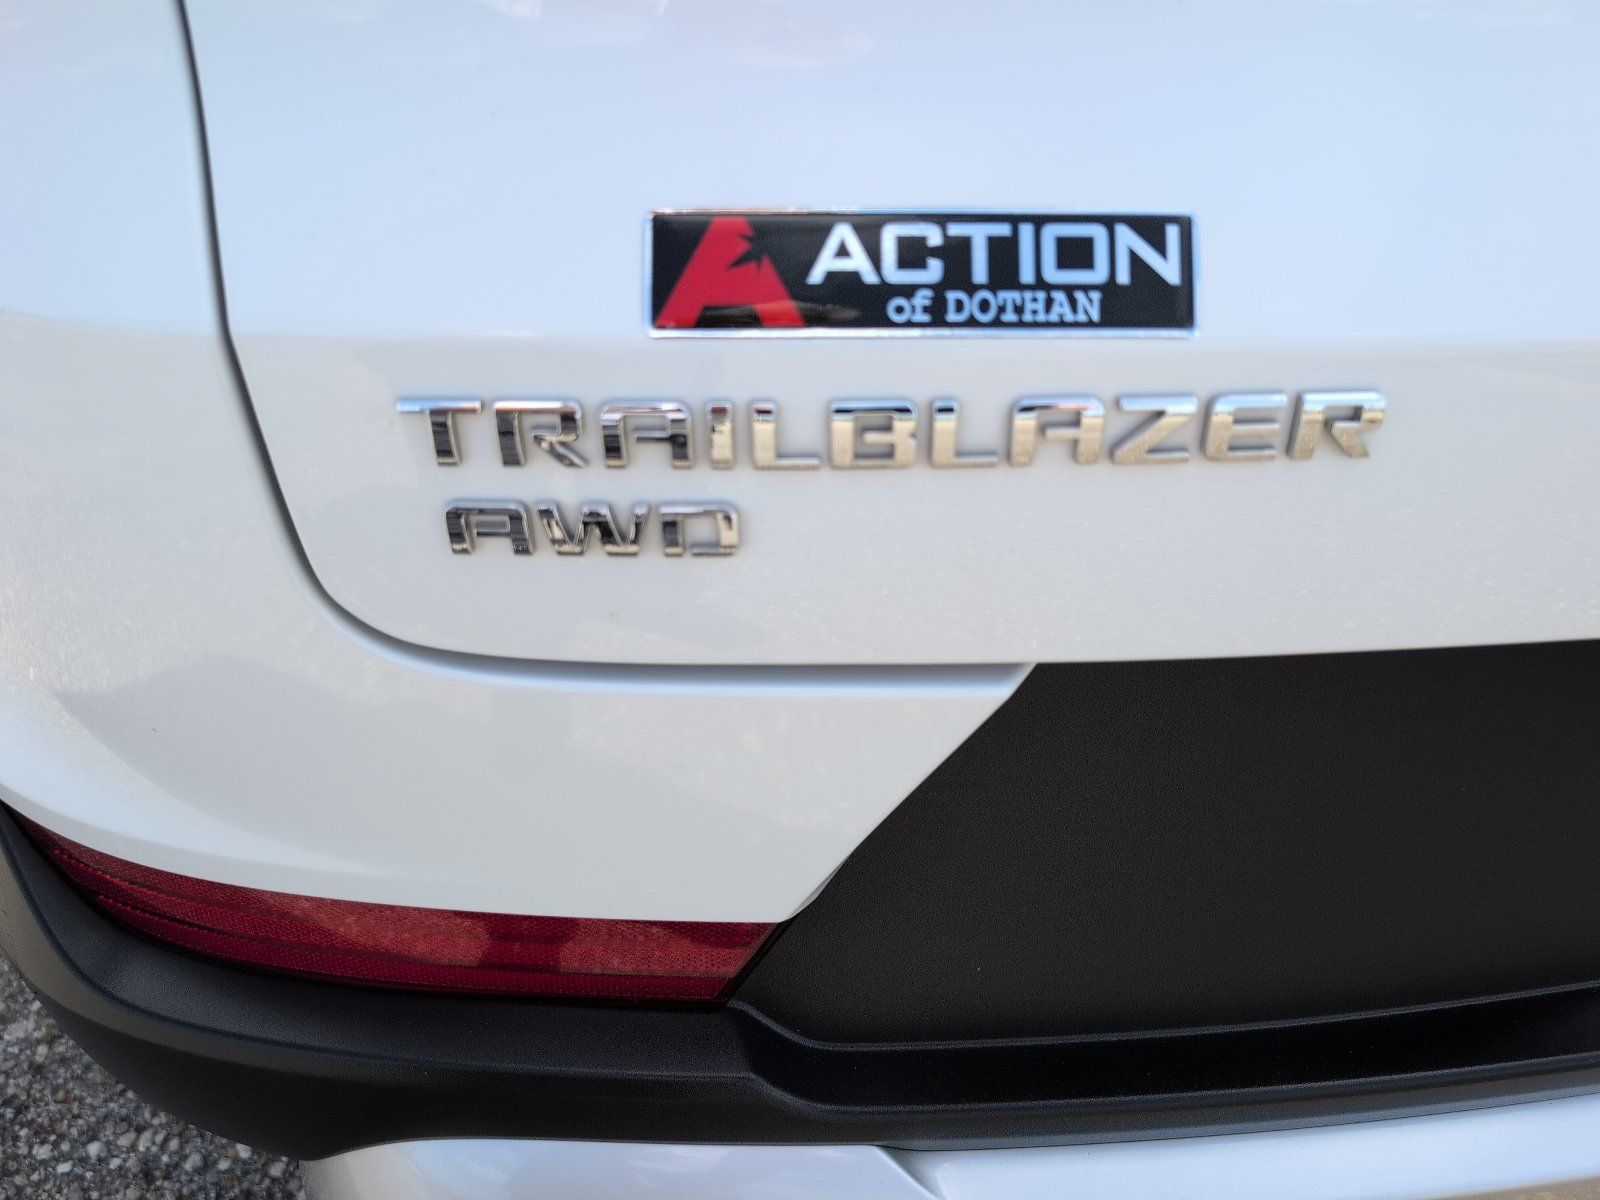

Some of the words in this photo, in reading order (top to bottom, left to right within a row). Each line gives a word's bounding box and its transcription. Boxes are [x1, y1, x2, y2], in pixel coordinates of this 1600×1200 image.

[805, 222, 1182, 286] ACTION
[886, 290, 933, 323] of
[945, 290, 1102, 323] DOTHAN
[396, 389, 1387, 470] TRAILBLAZER
[445, 500, 741, 557] AWD
